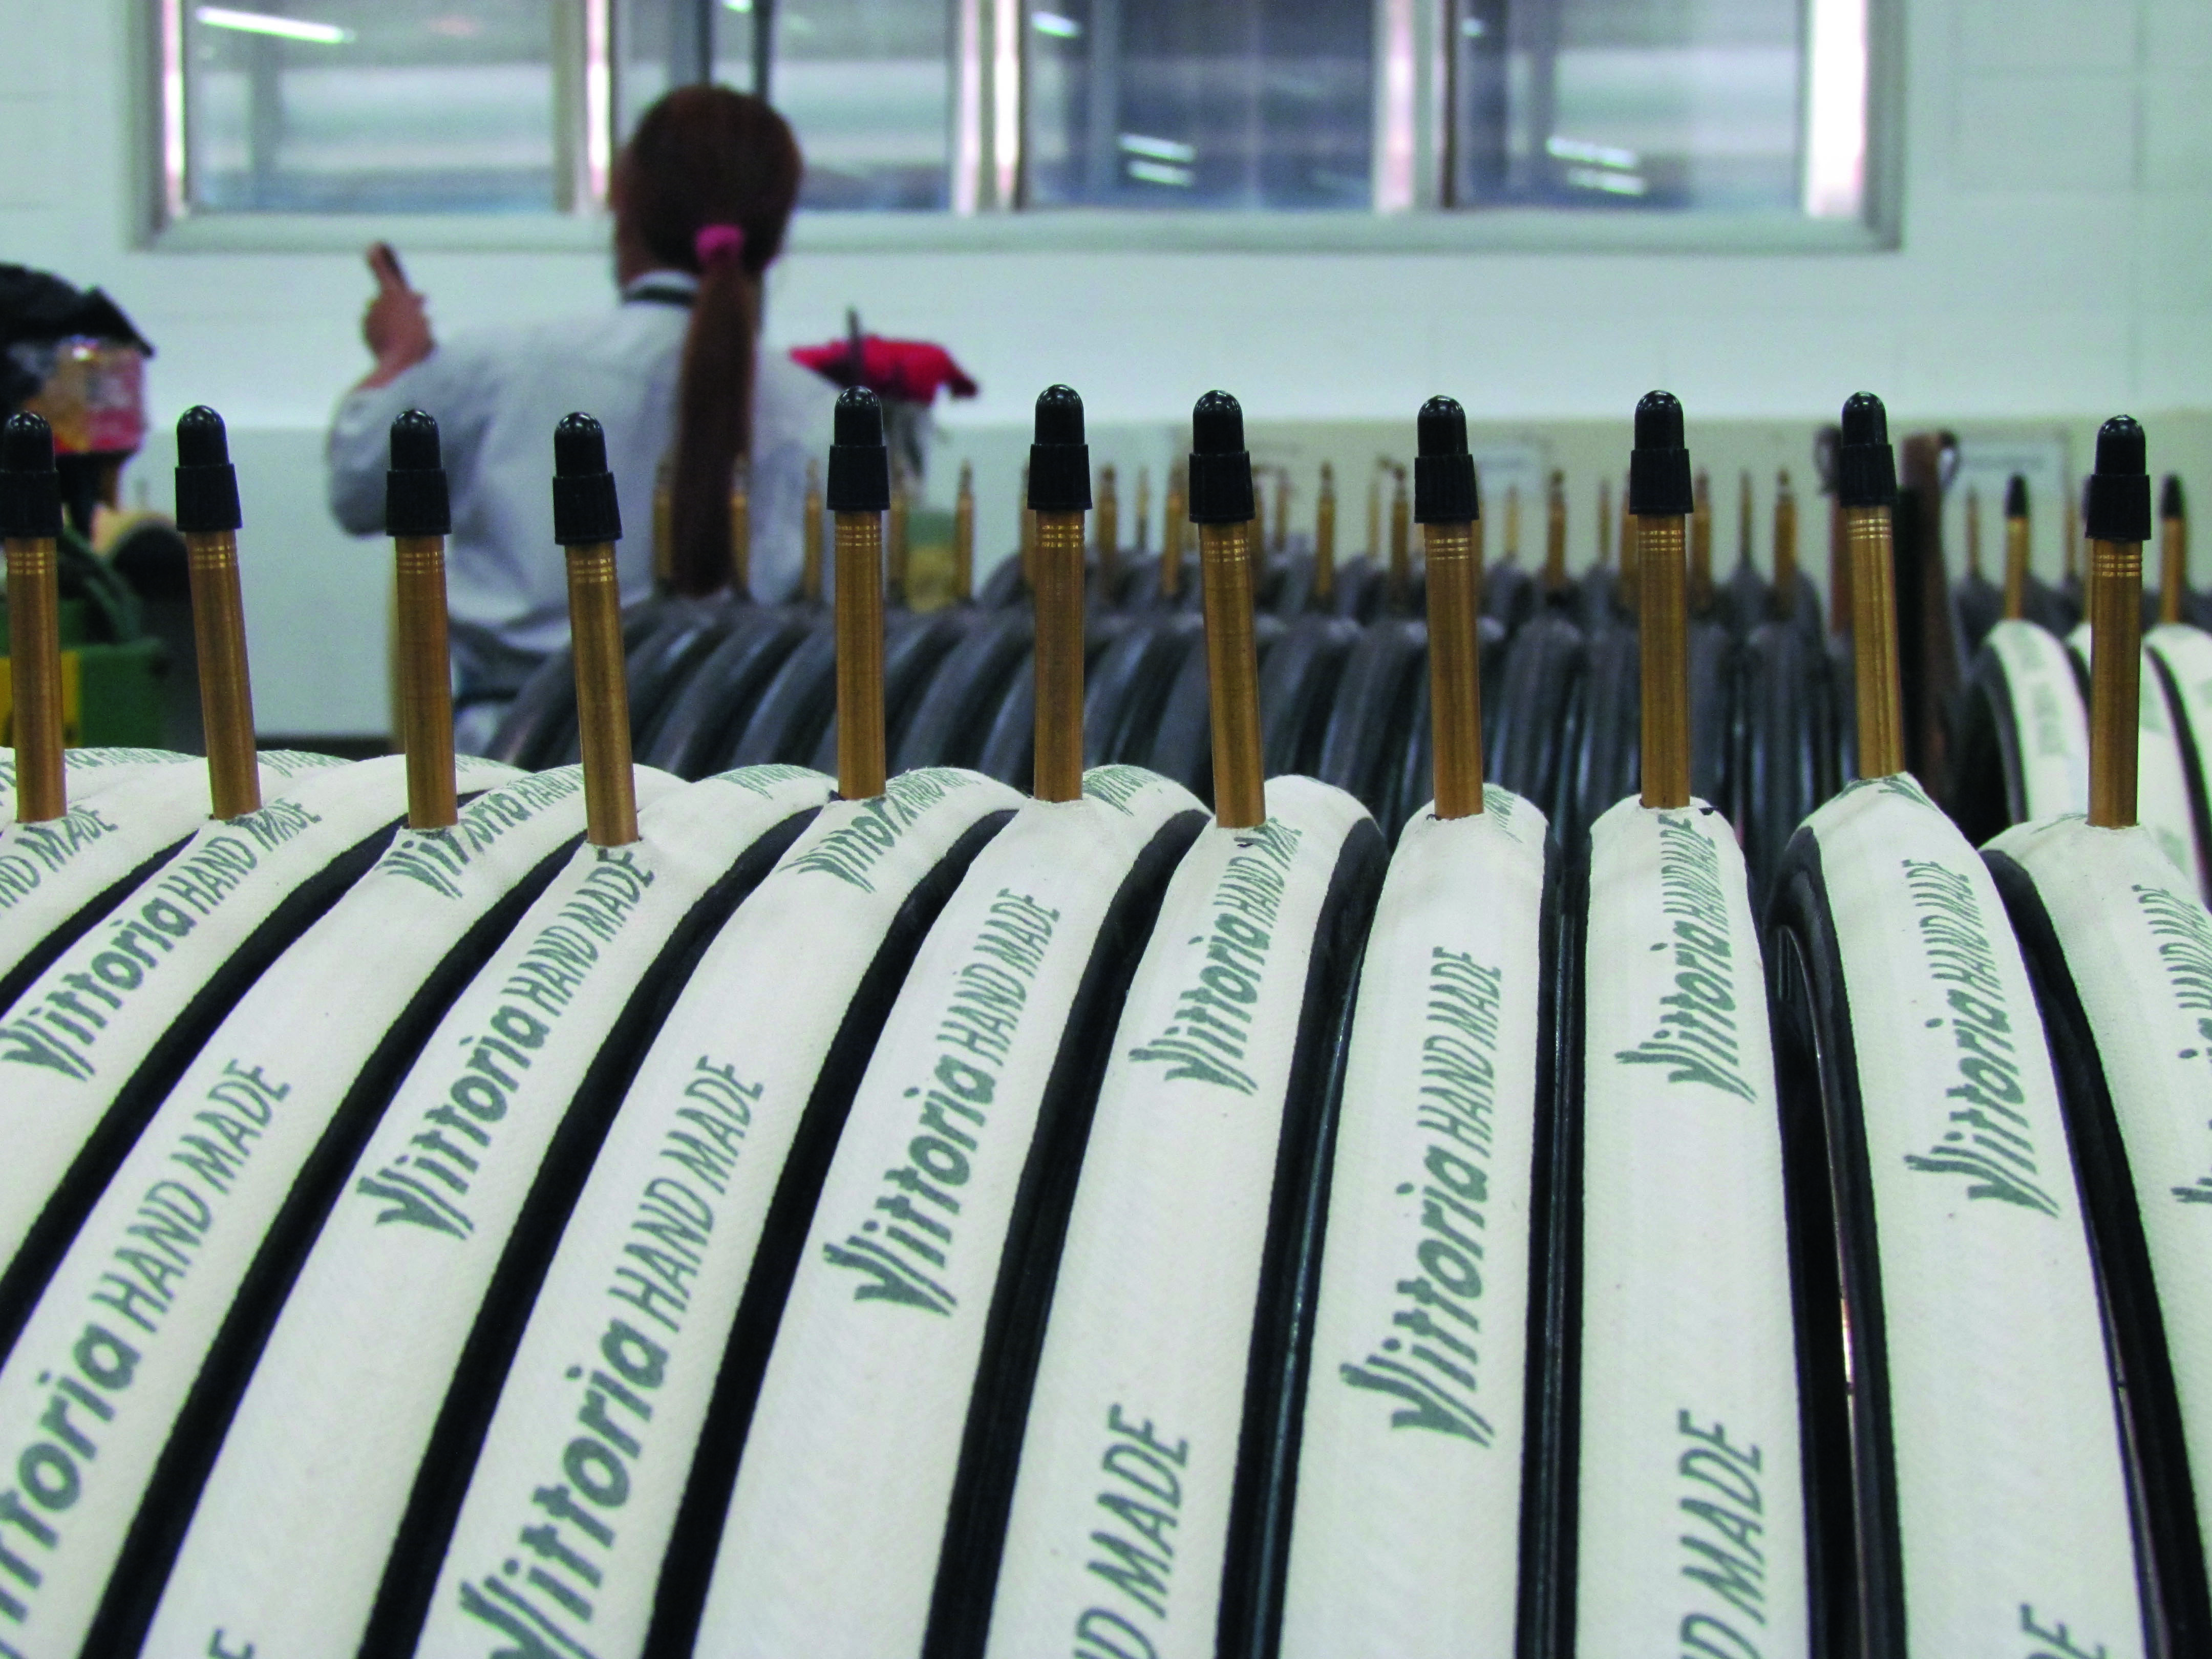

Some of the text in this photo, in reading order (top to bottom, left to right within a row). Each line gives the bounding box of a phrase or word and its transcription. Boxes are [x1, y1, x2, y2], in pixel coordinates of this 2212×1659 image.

[0, 897, 198, 1081] Vittoria
[157, 836, 258, 916] HAND
[14, 805, 118, 873] MADE
[1661, 864, 1731, 936] HAND
[356, 848, 655, 1241] Vittoria HAND MADE
[1128, 912, 1271, 1096] Vittoria
[1212, 856, 1285, 929] HAND
[1614, 920, 1757, 1104] Vittoria
[1901, 859, 2060, 1219] Vittoria HAND MADE
[88, 1181, 212, 1333] HAND
[169, 1058, 292, 1195] MADE
[606, 1177, 714, 1333] HAND
[660, 1054, 764, 1196] MADE
[822, 887, 1061, 1316] Vittoria HAND MADE
[1339, 946, 1502, 1449] Vittoria HAND MADE
[1086, 1402, 1189, 1620] MADE
[1677, 1408, 1768, 1628] MADE
